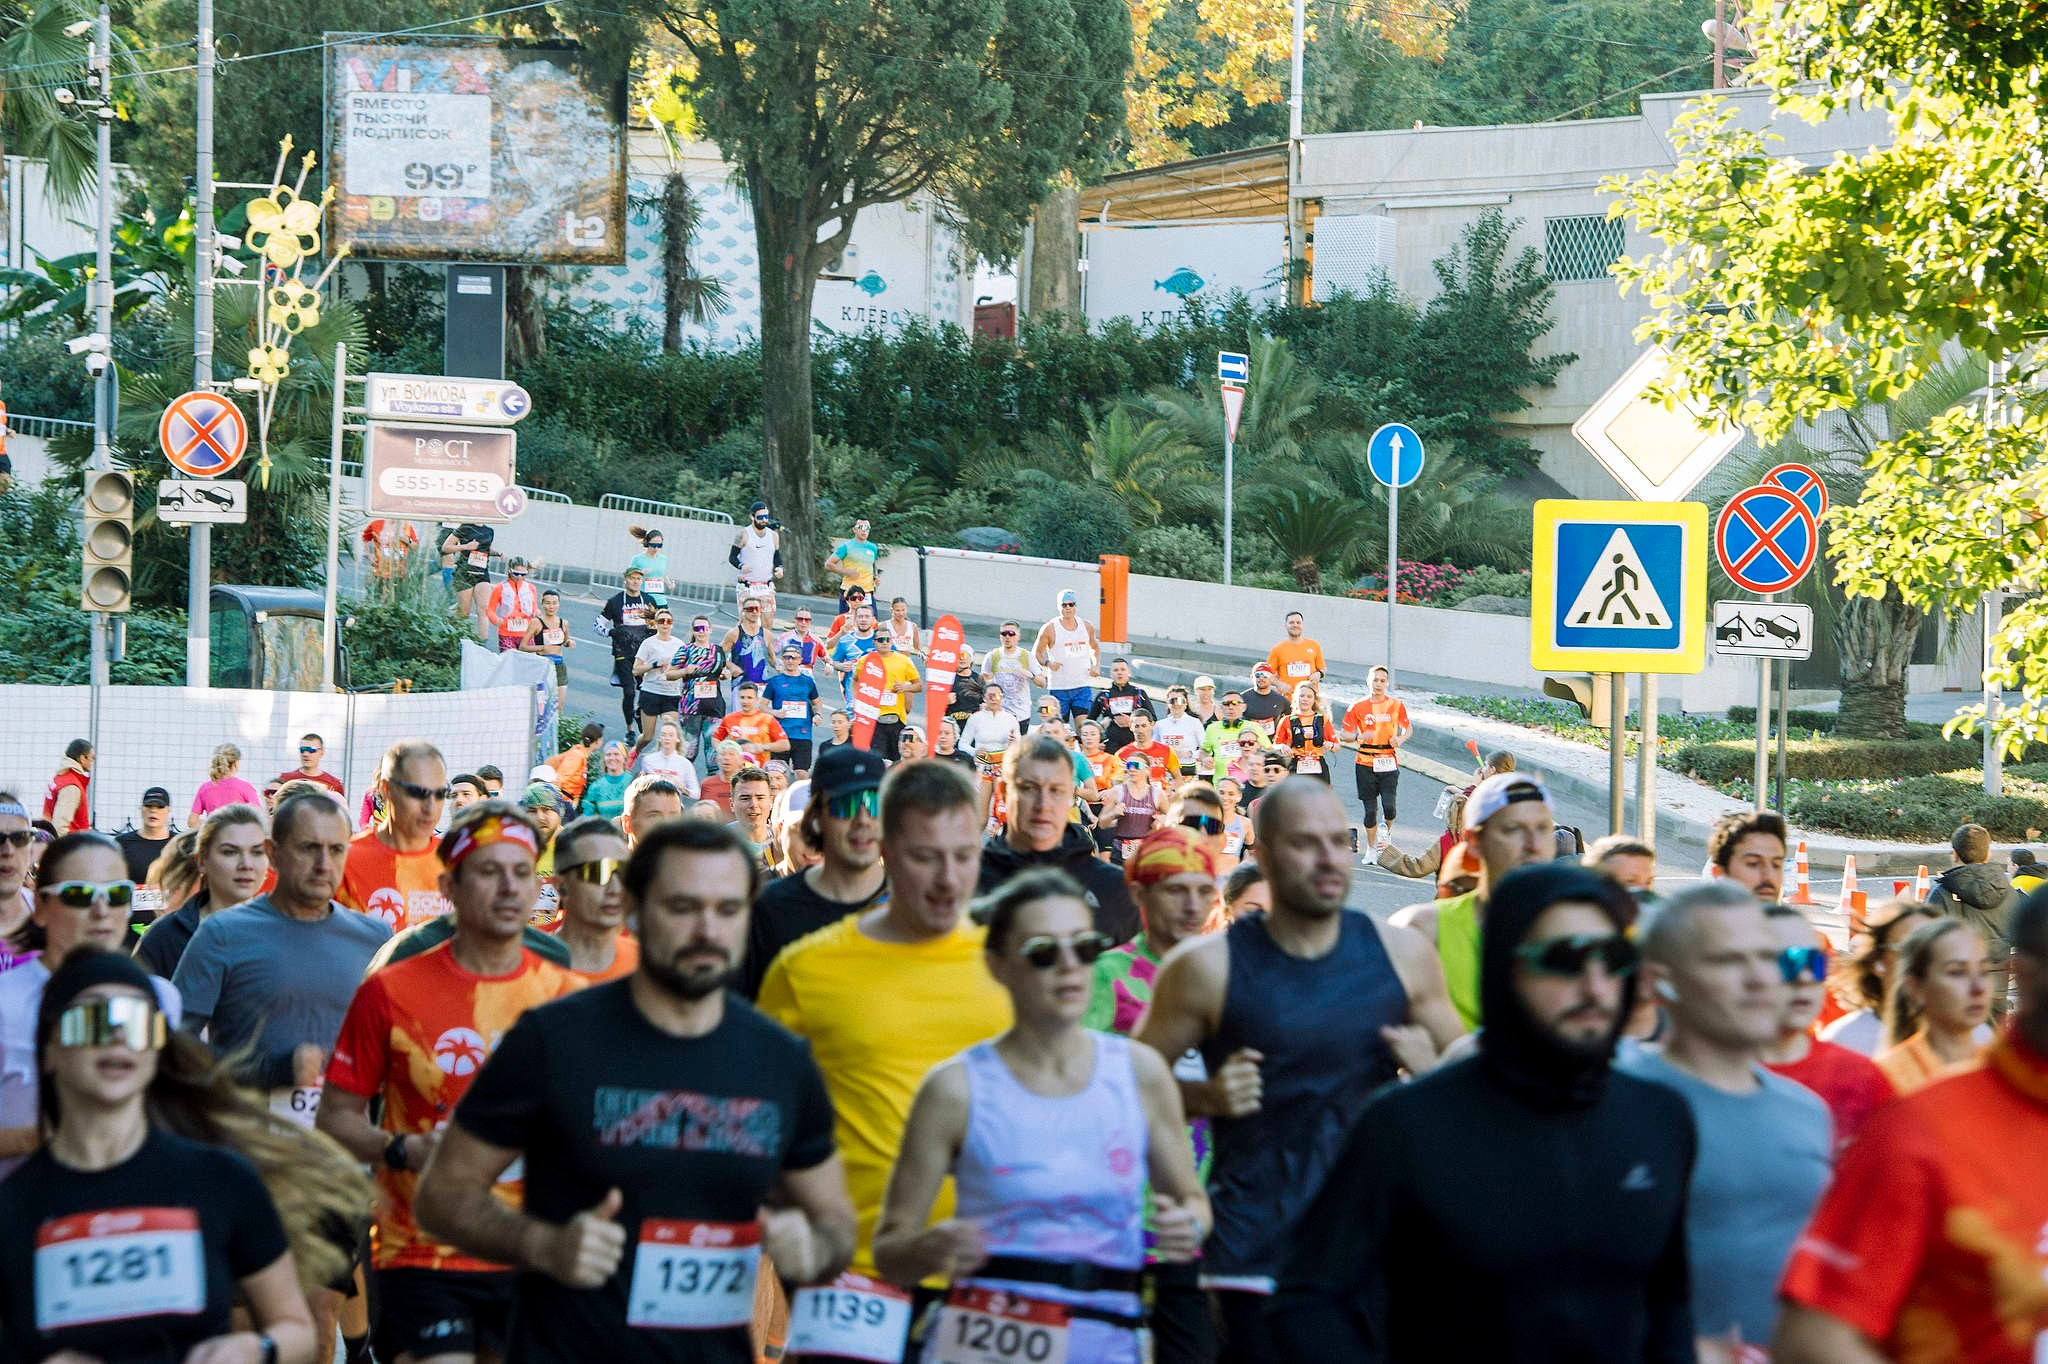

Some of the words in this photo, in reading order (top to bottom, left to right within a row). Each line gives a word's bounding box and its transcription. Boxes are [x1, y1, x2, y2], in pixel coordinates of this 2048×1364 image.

[353, 98, 427, 111] ВМЕСТО
[353, 112, 428, 125] ТЫСЯЧИ
[353, 127, 452, 140] ПОДПИСОК
[841, 305, 900, 326] КЛЁВО
[394, 475, 489, 494] 555-1-555
[65, 1245, 172, 1288] 1281
[659, 1258, 747, 1294] 1372
[811, 1293, 886, 1325] 1139
[956, 1312, 1052, 1362] 1200
